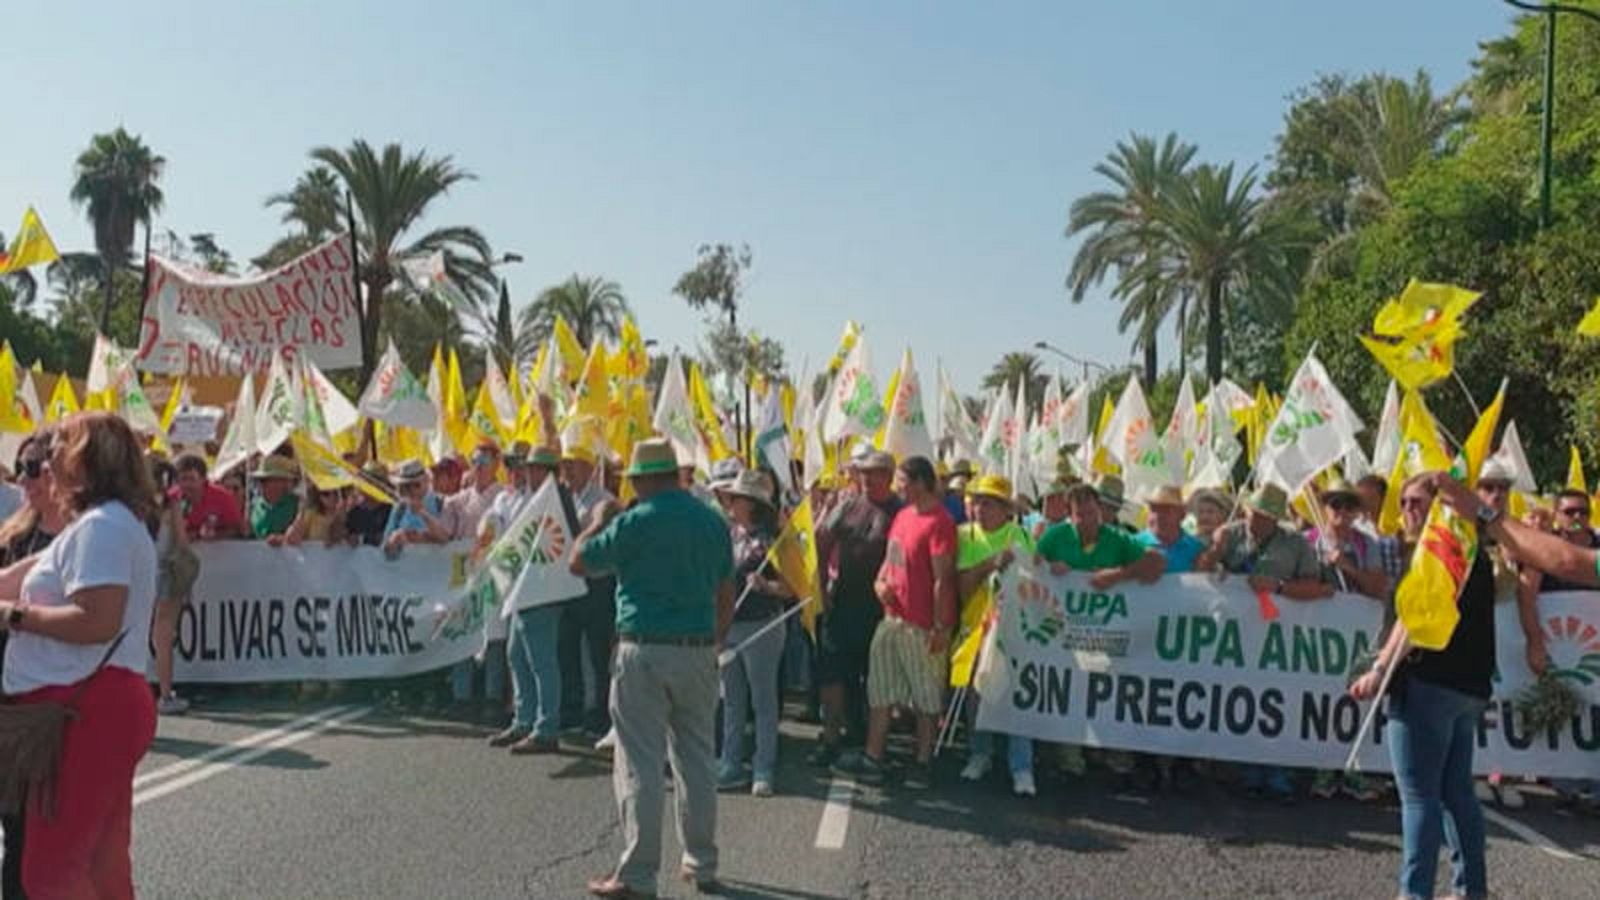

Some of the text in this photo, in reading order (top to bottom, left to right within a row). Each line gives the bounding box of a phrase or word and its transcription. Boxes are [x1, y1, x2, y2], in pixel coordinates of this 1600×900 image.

[176, 599, 287, 661] OLIVAR
[293, 596, 331, 657] SE
[336, 594, 424, 656] MUERE
[1065, 590, 1129, 625] UPA
[1155, 614, 1245, 668] UPA
[1258, 620, 1372, 678] ANDA
[1085, 672, 1284, 738] PRECIOS
[1300, 690, 1361, 744] NO
